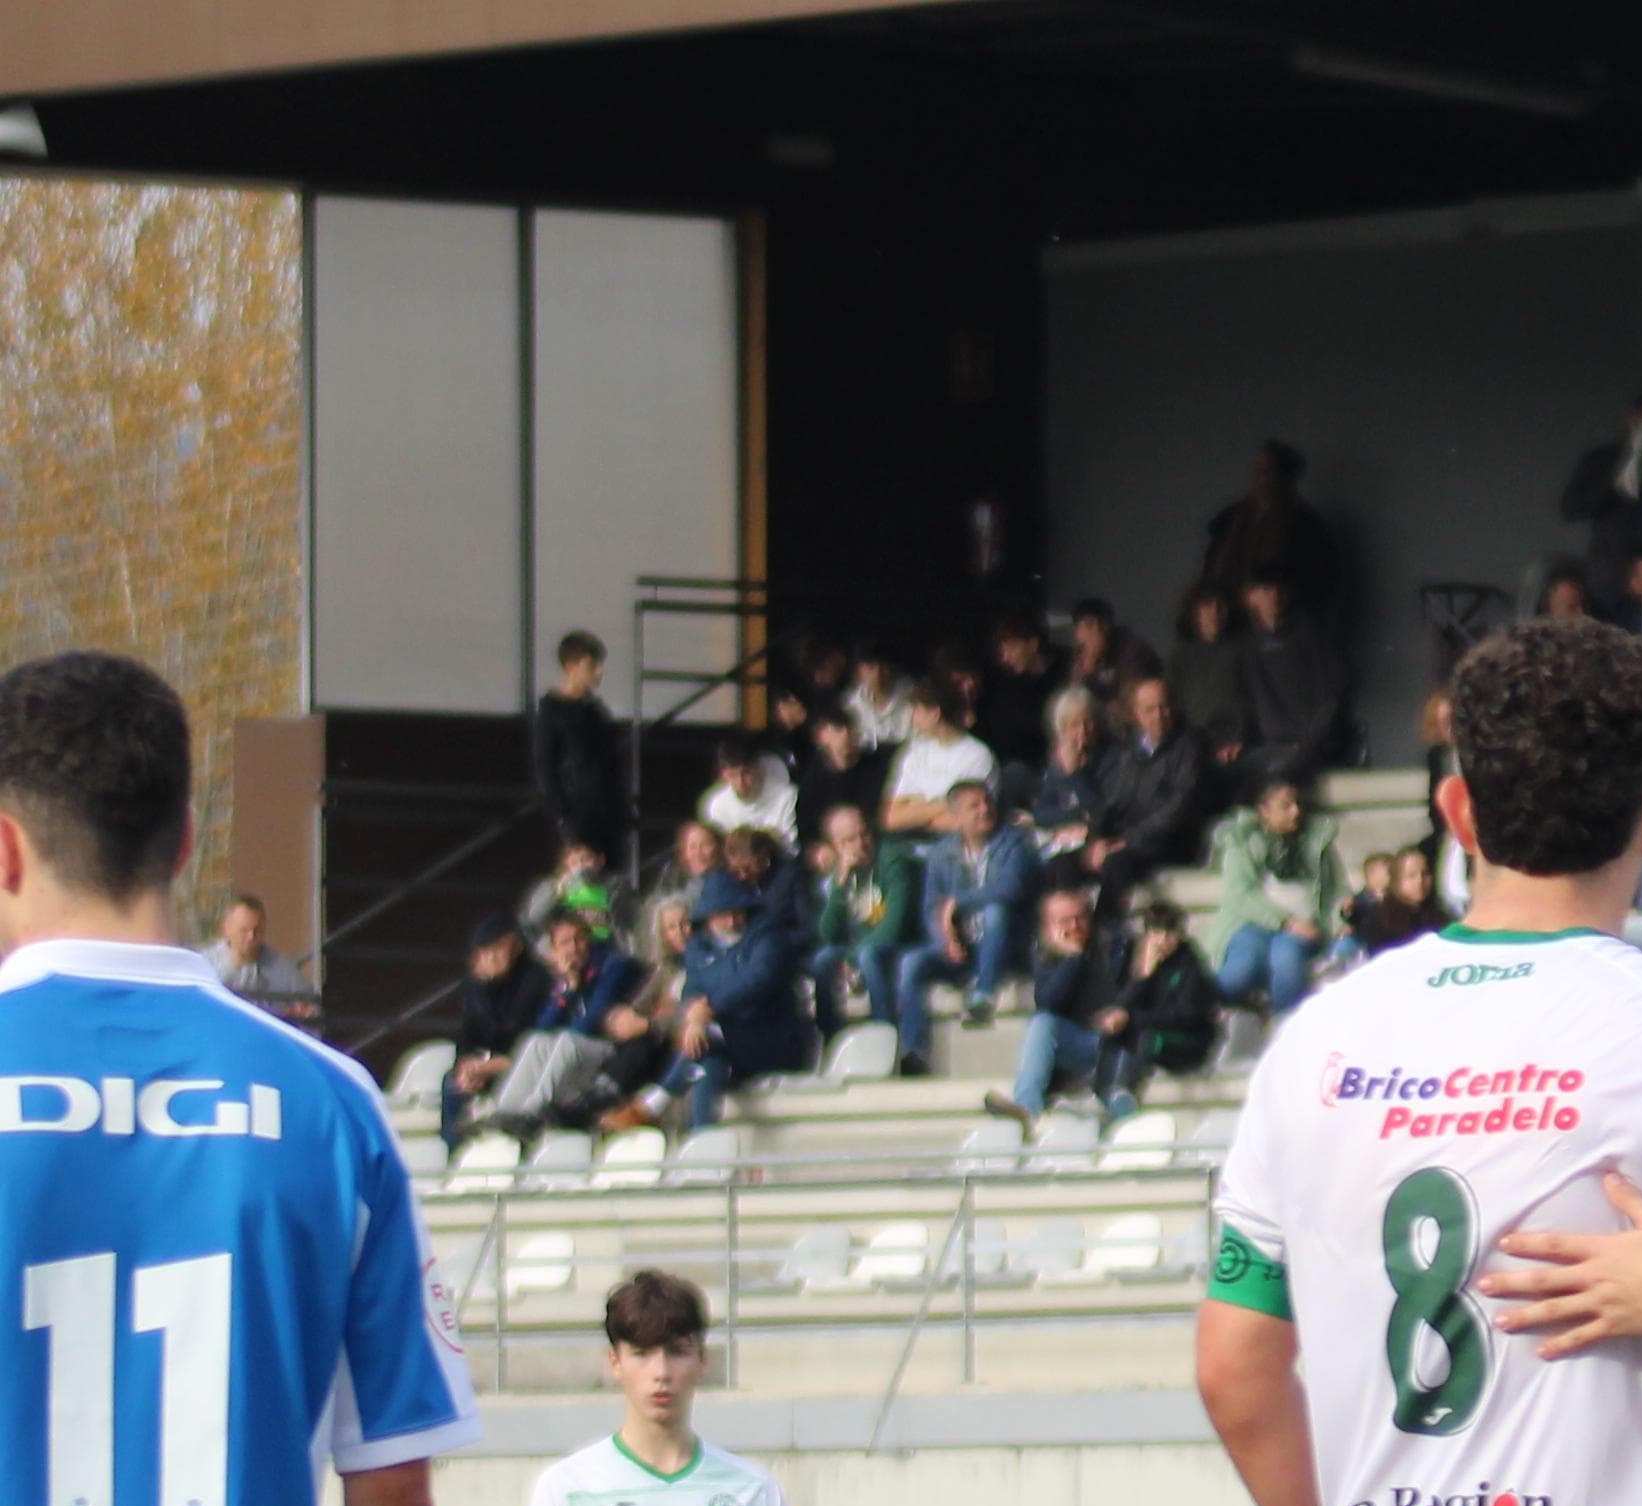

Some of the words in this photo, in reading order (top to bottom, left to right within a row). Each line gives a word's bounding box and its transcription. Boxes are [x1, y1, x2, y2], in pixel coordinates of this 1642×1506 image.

[0, 1075, 282, 1141] DIGI
[1379, 1097, 1580, 1140] Paradelo
[1382, 1164, 1494, 1437] 8
